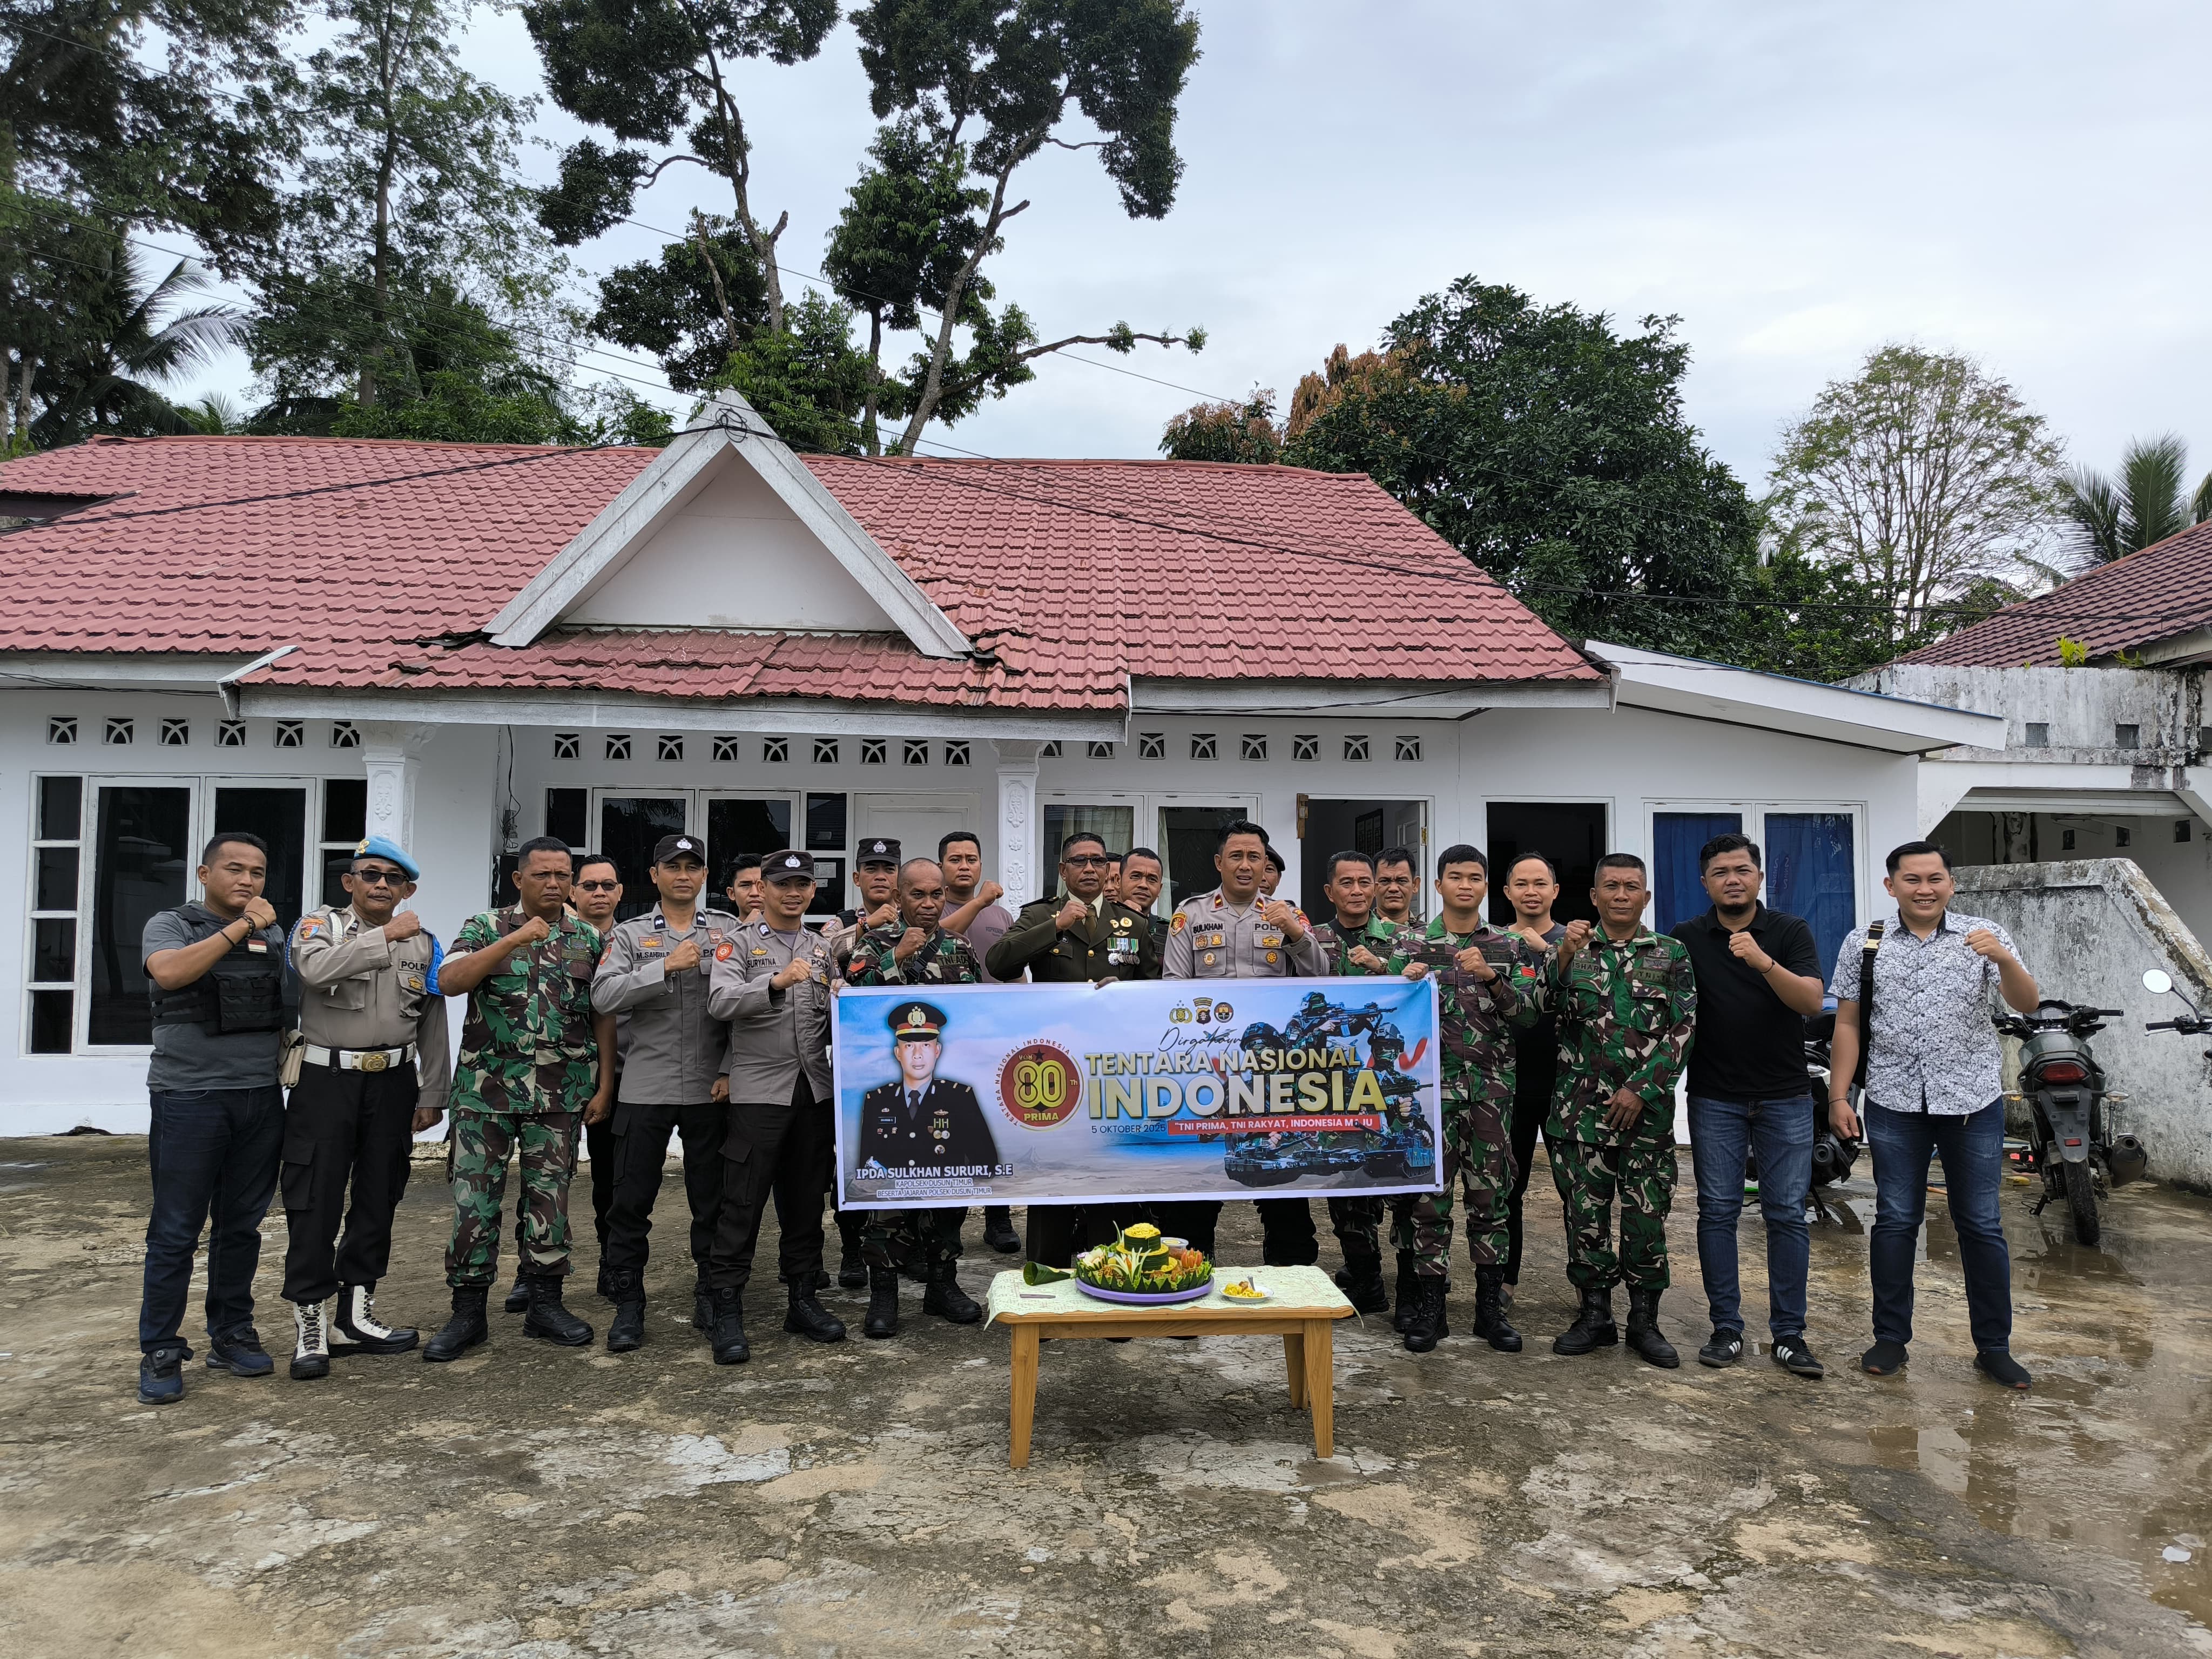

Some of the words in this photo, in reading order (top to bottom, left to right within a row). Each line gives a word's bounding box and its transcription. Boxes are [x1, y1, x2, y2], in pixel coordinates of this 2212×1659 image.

[1023, 1038, 1070, 1055] INDONESIA
[995, 1045, 1021, 1084] NASIONAL
[1085, 1050, 1212, 1075] TENTARA
[1219, 1047, 1361, 1073] NASIONAL
[1013, 1060, 1067, 1108] 80
[1089, 1069, 1387, 1119] INDONESIA
[995, 1089, 1019, 1127] TENTARA
[1024, 1112, 1059, 1122] PRIMA
[1196, 1122, 1228, 1130] PRIMA,
[1231, 1121, 1246, 1129] TNI
[1248, 1120, 1289, 1129] RAKYAT,
[1291, 1118, 1343, 1127] INDONESIA
[1091, 1125, 1097, 1134] 5
[1100, 1124, 1141, 1133] OKTOBER
[1144, 1124, 1166, 1132] 2025
[856, 1169, 886, 1179] IPDA
[887, 1166, 941, 1178] SULKHAN
[944, 1165, 992, 1178] SURURI,
[995, 1164, 1013, 1176] S.E
[896, 1179, 927, 1188] KAPOLSEK
